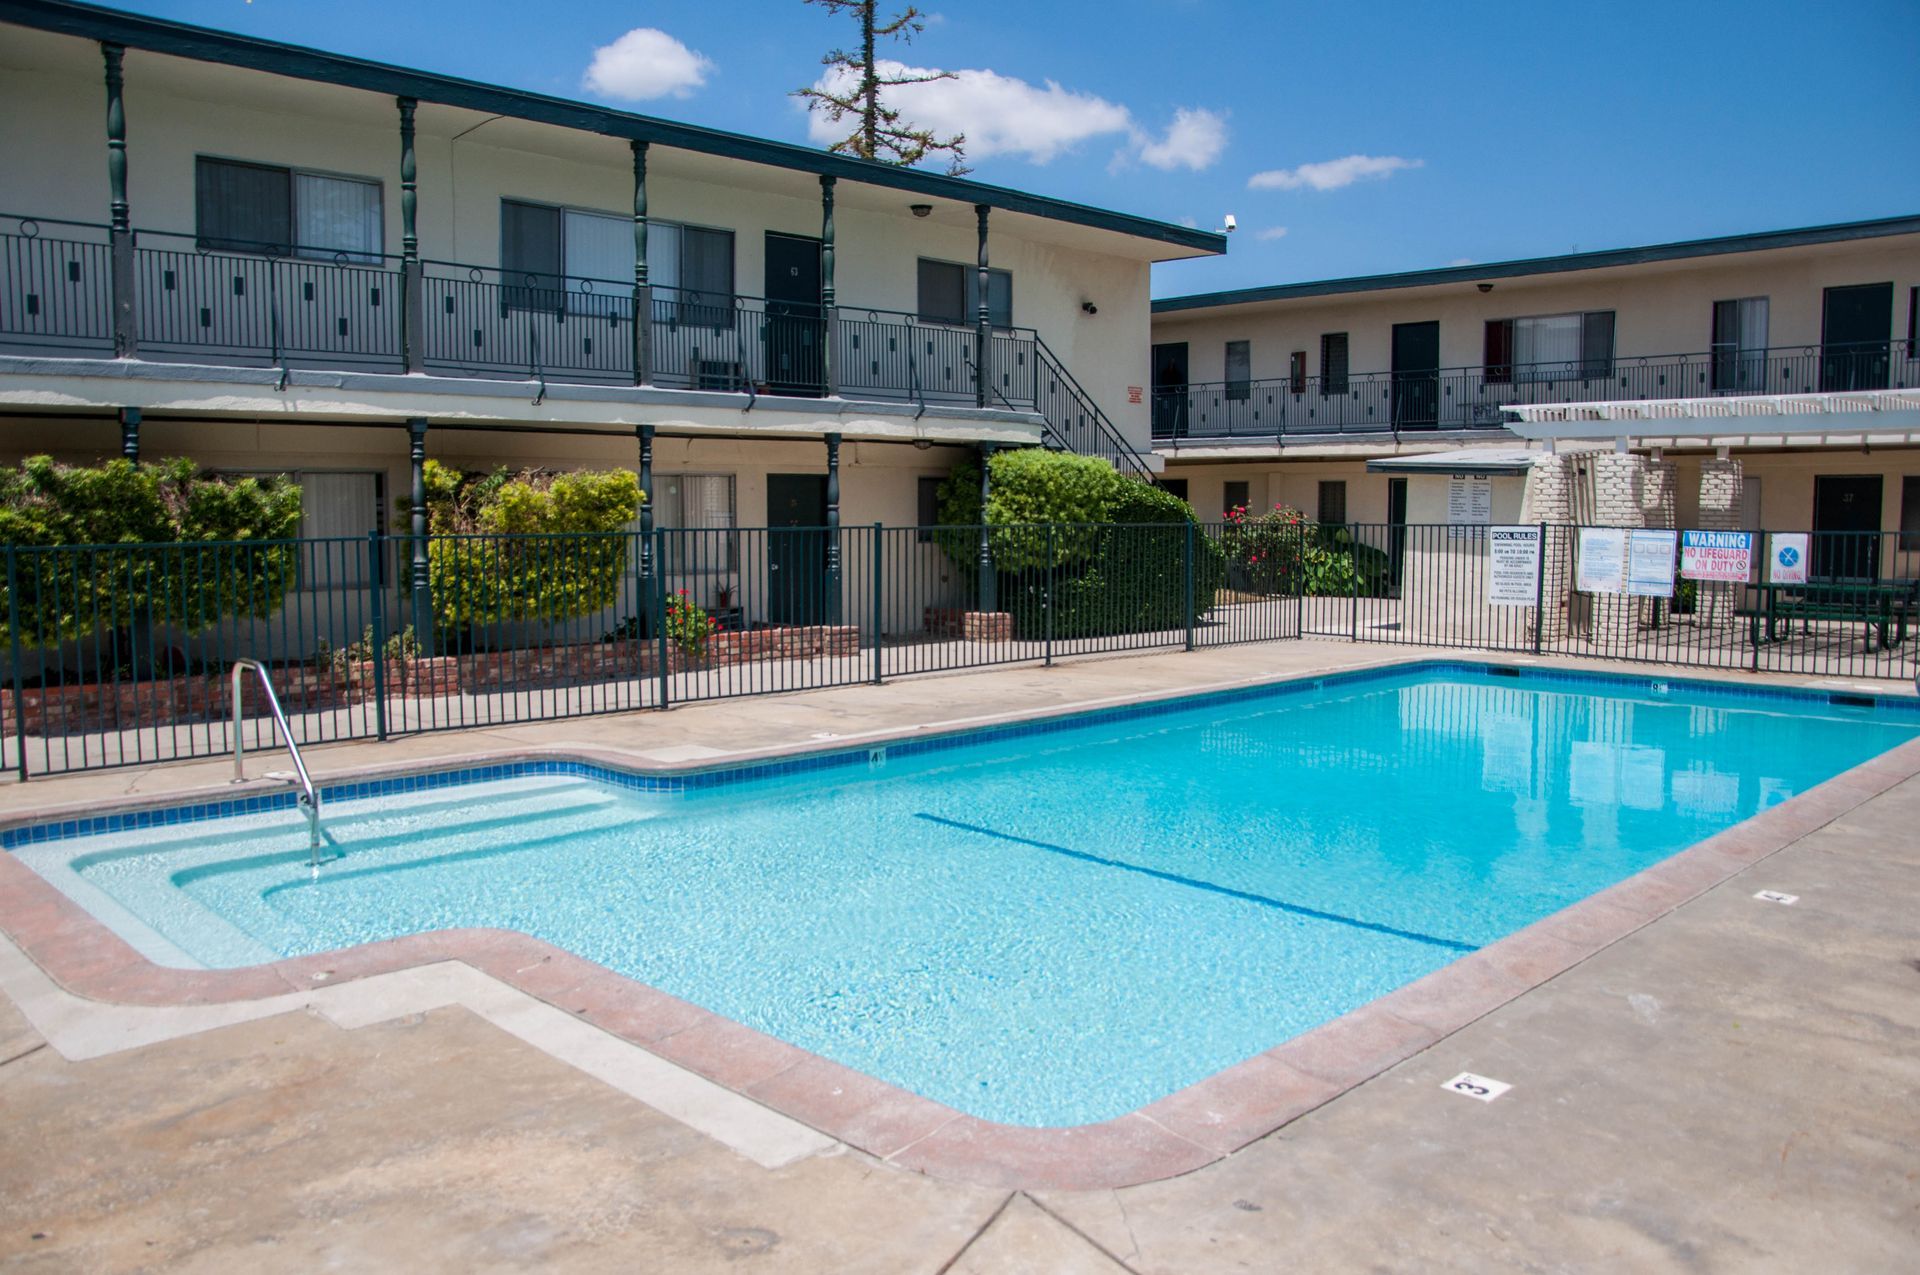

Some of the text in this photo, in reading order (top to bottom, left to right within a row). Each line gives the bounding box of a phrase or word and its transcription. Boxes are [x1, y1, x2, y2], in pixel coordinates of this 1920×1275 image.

[1513, 532, 1537, 540] RULES
[1689, 532, 1746, 548] WARNING
[1684, 547, 1748, 560] NO LIFEGUARD
[1695, 560, 1734, 572] ON DUTY
[1454, 1082, 1489, 1095] 3
